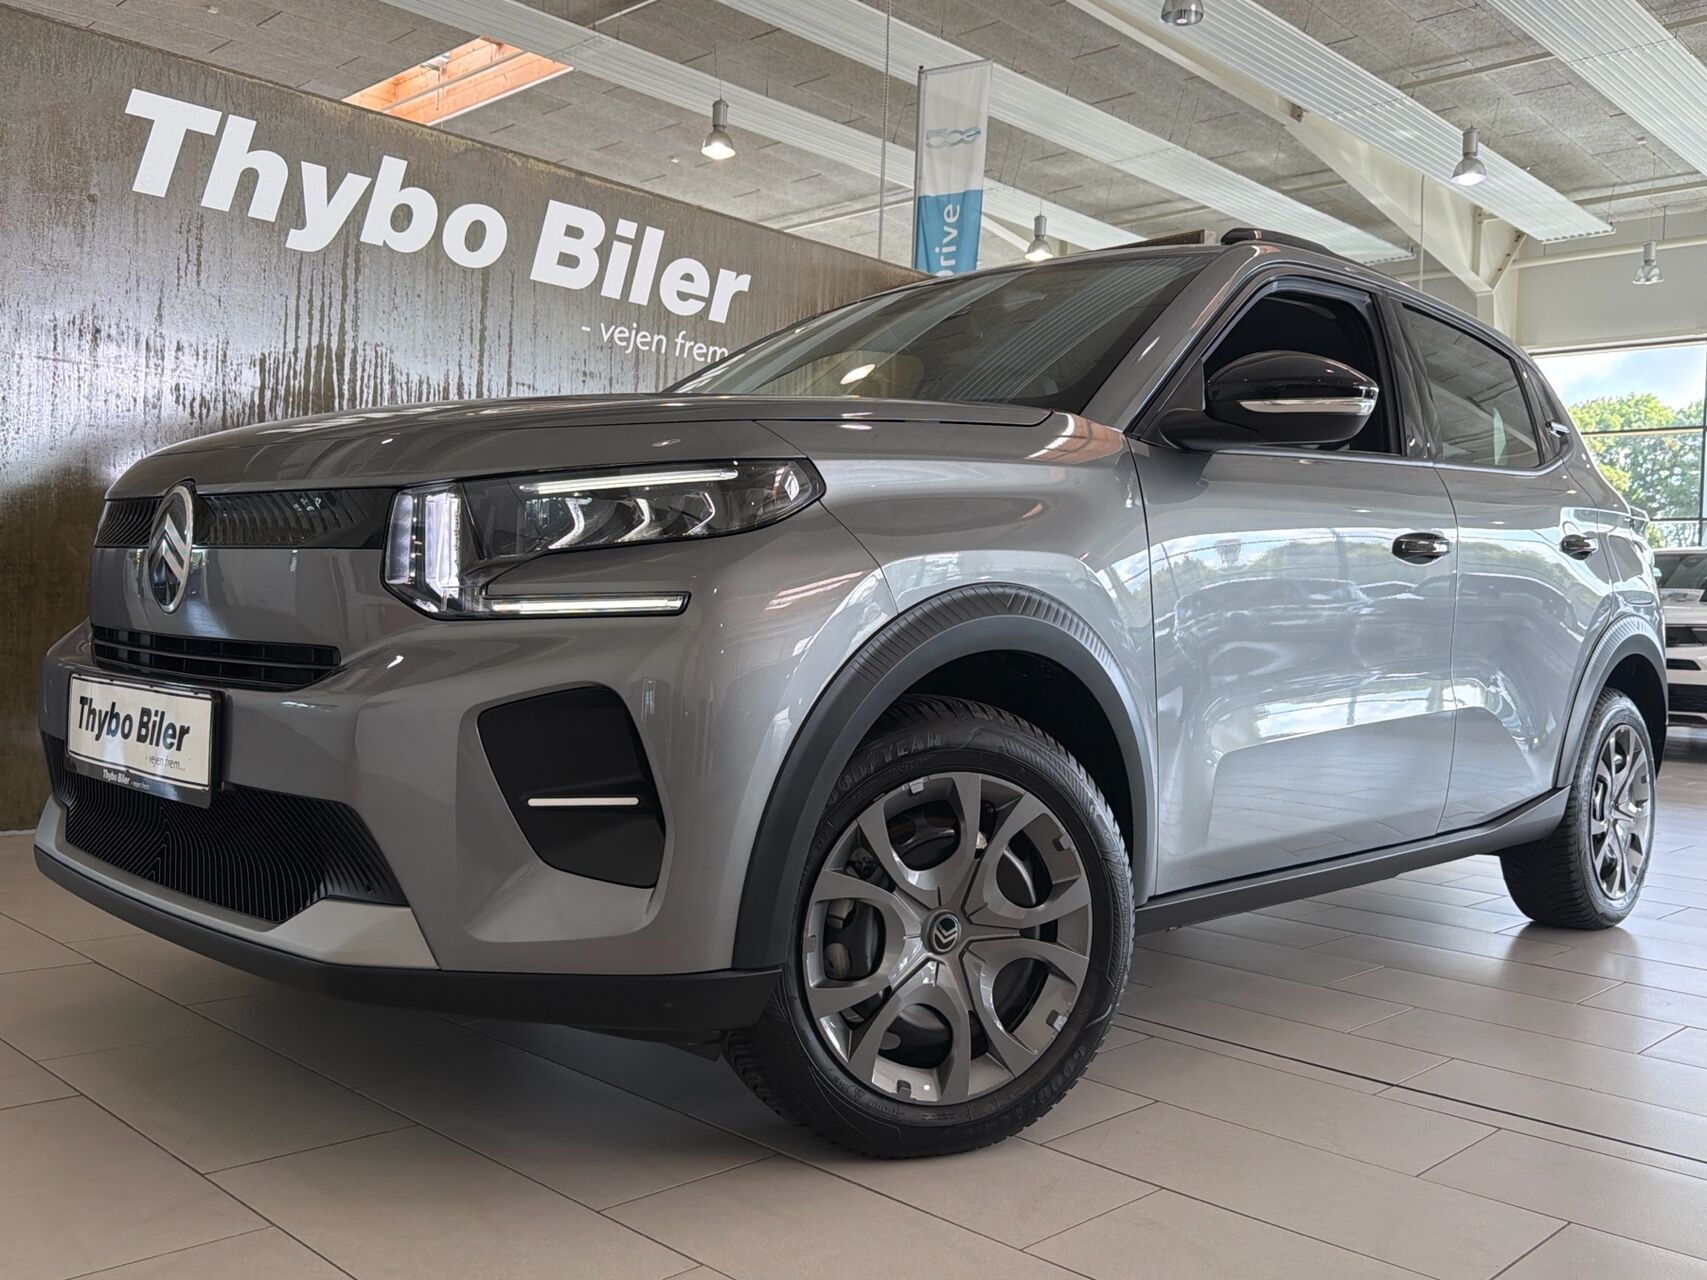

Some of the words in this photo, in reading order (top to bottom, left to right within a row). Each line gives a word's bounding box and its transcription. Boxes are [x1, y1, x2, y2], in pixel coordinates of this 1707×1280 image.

[124, 88, 508, 269] Thybo
[529, 199, 752, 324] Biler
[600, 322, 667, 354] vejen
[78, 696, 133, 742] Thybo
[136, 707, 191, 752] Biler
[102, 769, 117, 782] Thybo
